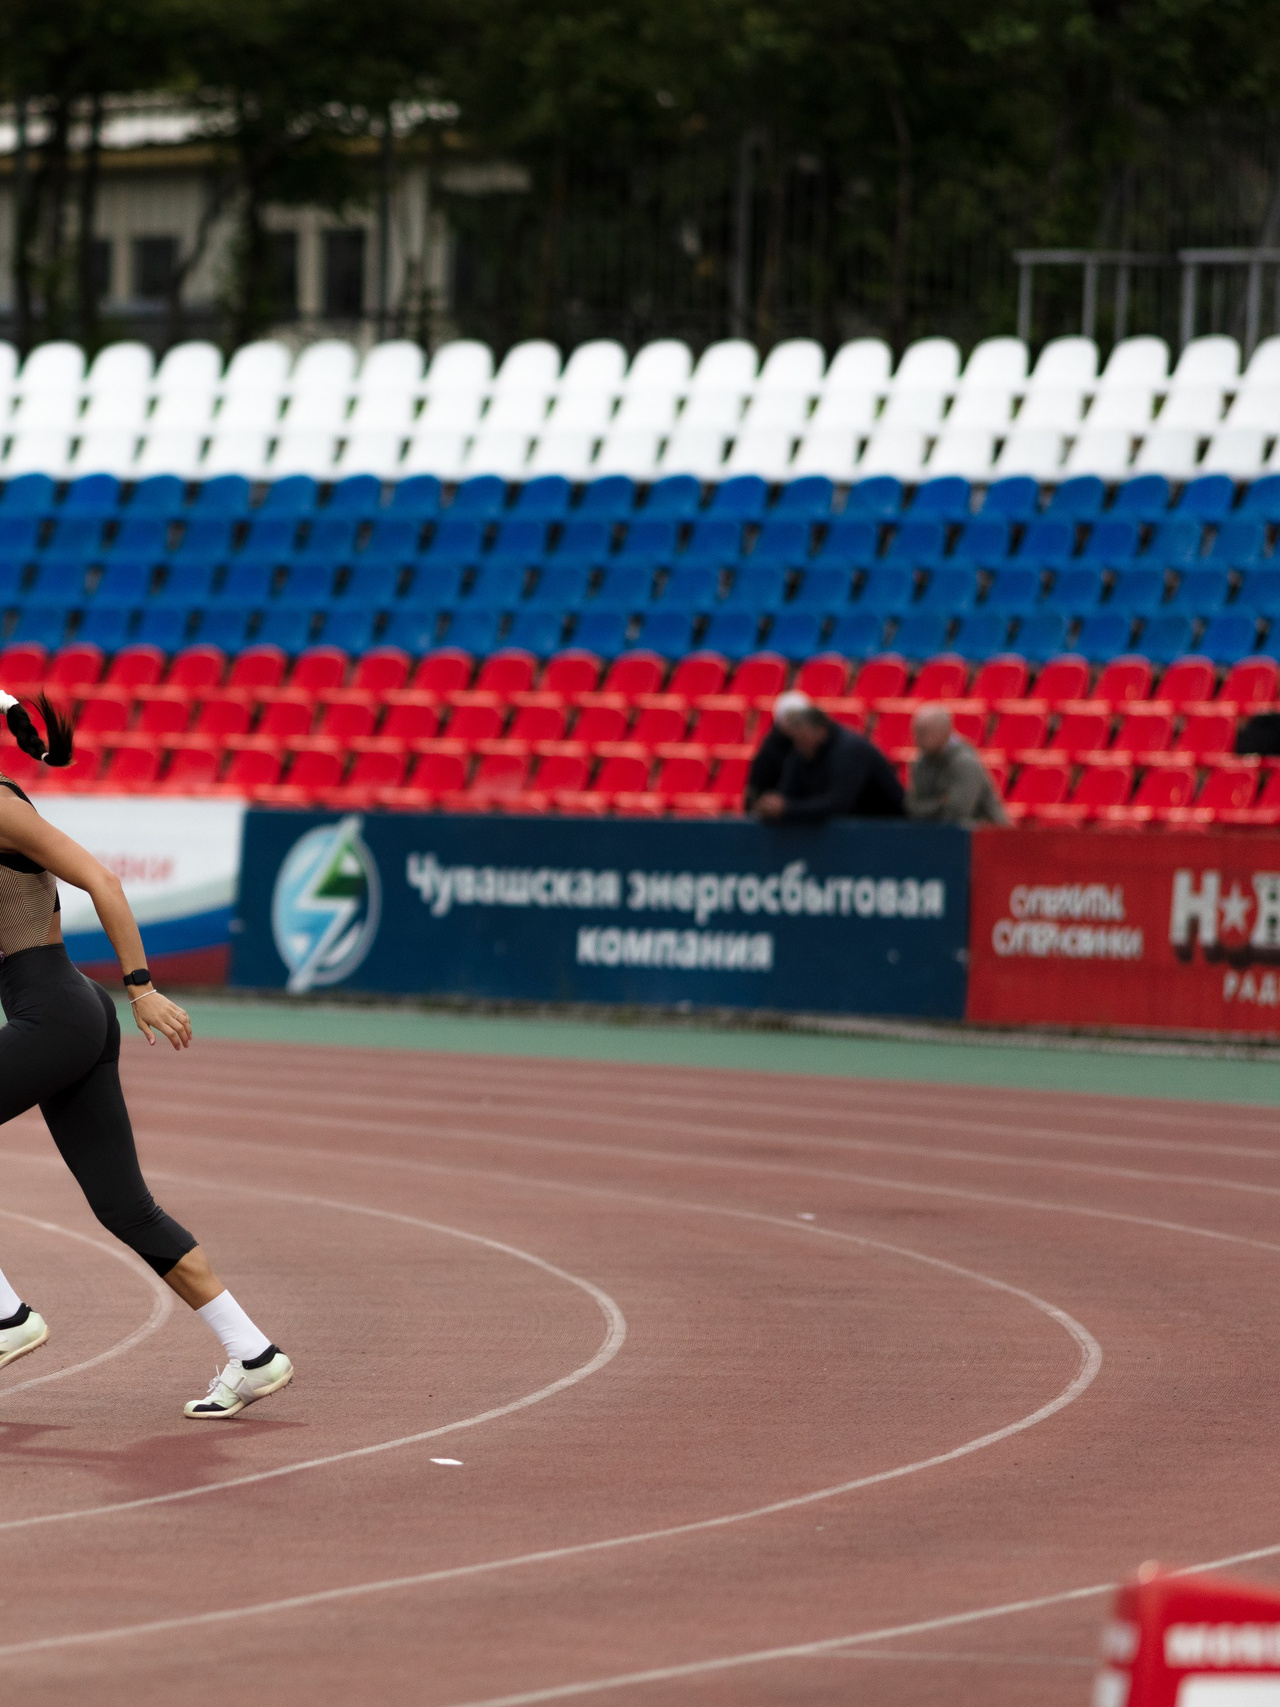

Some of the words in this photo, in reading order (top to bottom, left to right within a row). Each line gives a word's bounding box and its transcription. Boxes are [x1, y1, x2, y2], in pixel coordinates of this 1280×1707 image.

[406, 853, 618, 917] Чувашская
[626, 861, 946, 923] энергосбытовая
[576, 926, 773, 971] компания
